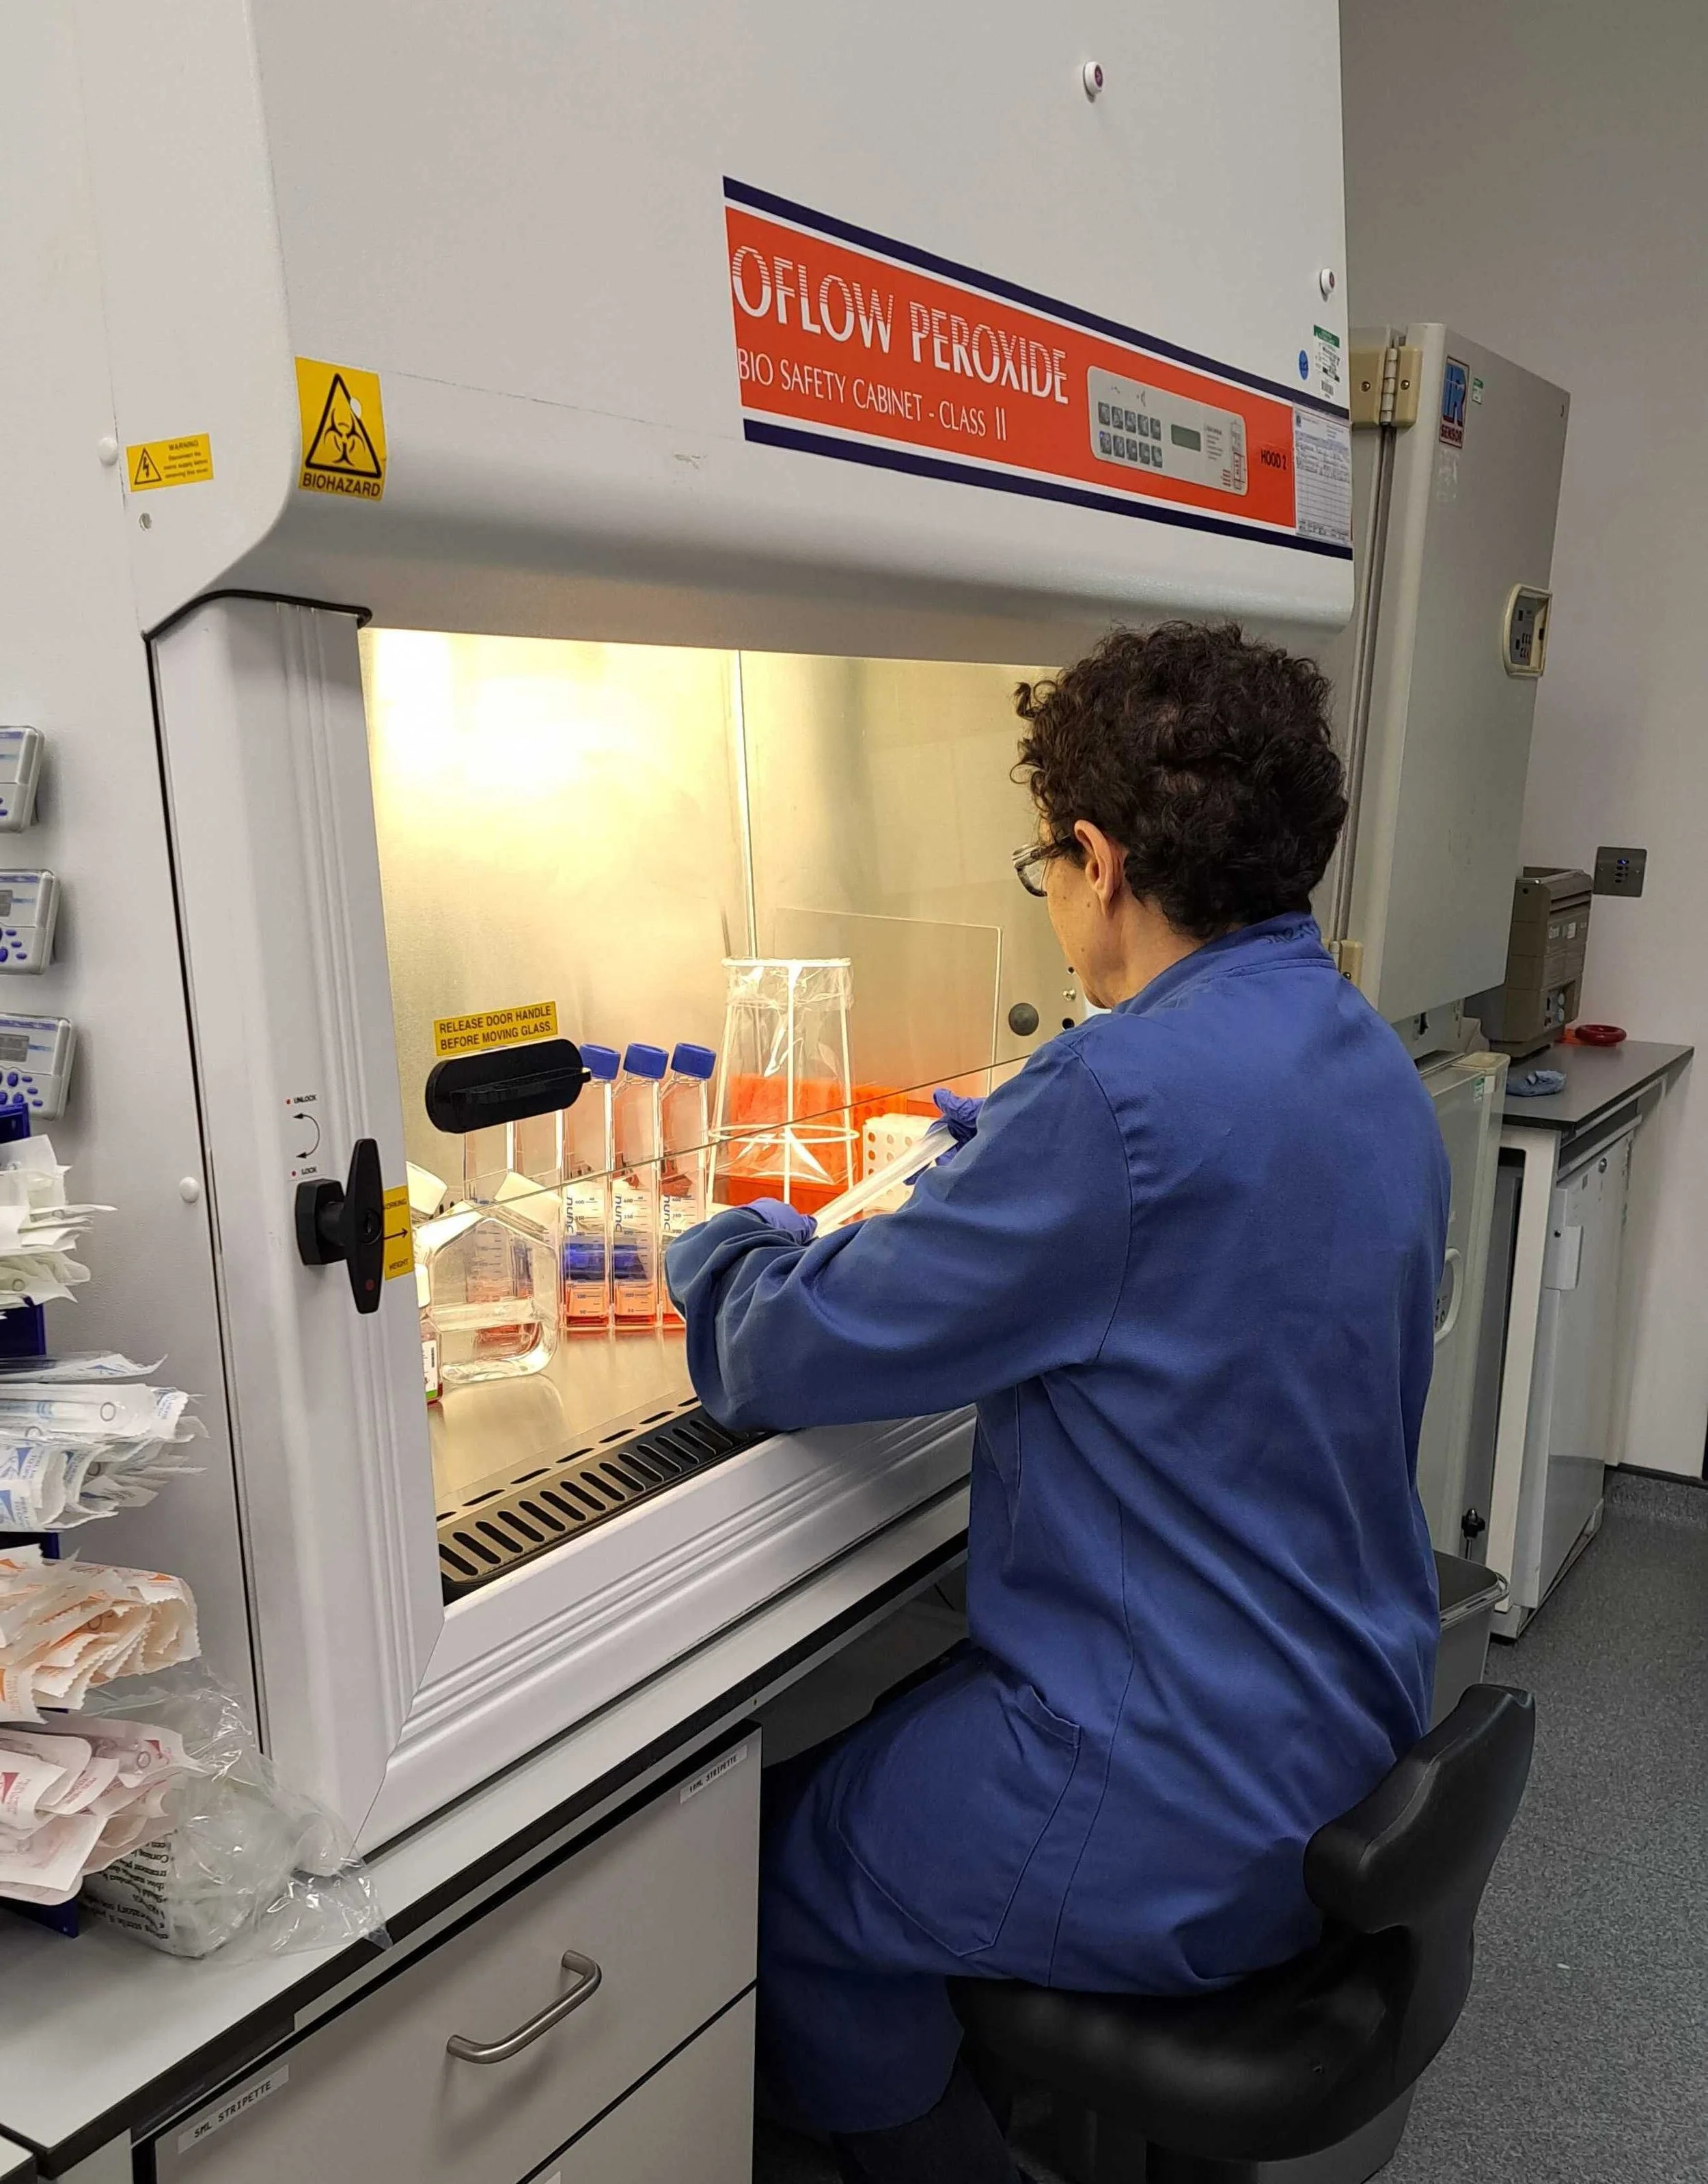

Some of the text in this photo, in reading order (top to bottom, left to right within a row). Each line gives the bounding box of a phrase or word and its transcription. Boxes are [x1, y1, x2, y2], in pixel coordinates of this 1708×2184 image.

[732, 245, 1069, 405] OFLOW PEROXIDE
[737, 347, 773, 386] BIO
[780, 359, 846, 405] SAFETY
[853, 379, 922, 422] CABINET
[939, 400, 987, 437] CLASS
[994, 406, 1007, 441] II
[168, 439, 199, 451] WARNING
[1440, 424, 1463, 444] SENSOR
[1261, 448, 1281, 469] HOOD
[302, 472, 381, 497] BIOHAZARD
[439, 1005, 551, 1034] RELEASE DOOR HANDLE
[440, 1021, 553, 1050] BEFORE MOVING GLASS.
[293, 1095, 317, 1104] UNLOCK
[301, 1166, 317, 1175] LOCK
[706, 1754, 737, 1782] STRIPETTE
[217, 2080, 272, 2122] STRIPETTE
